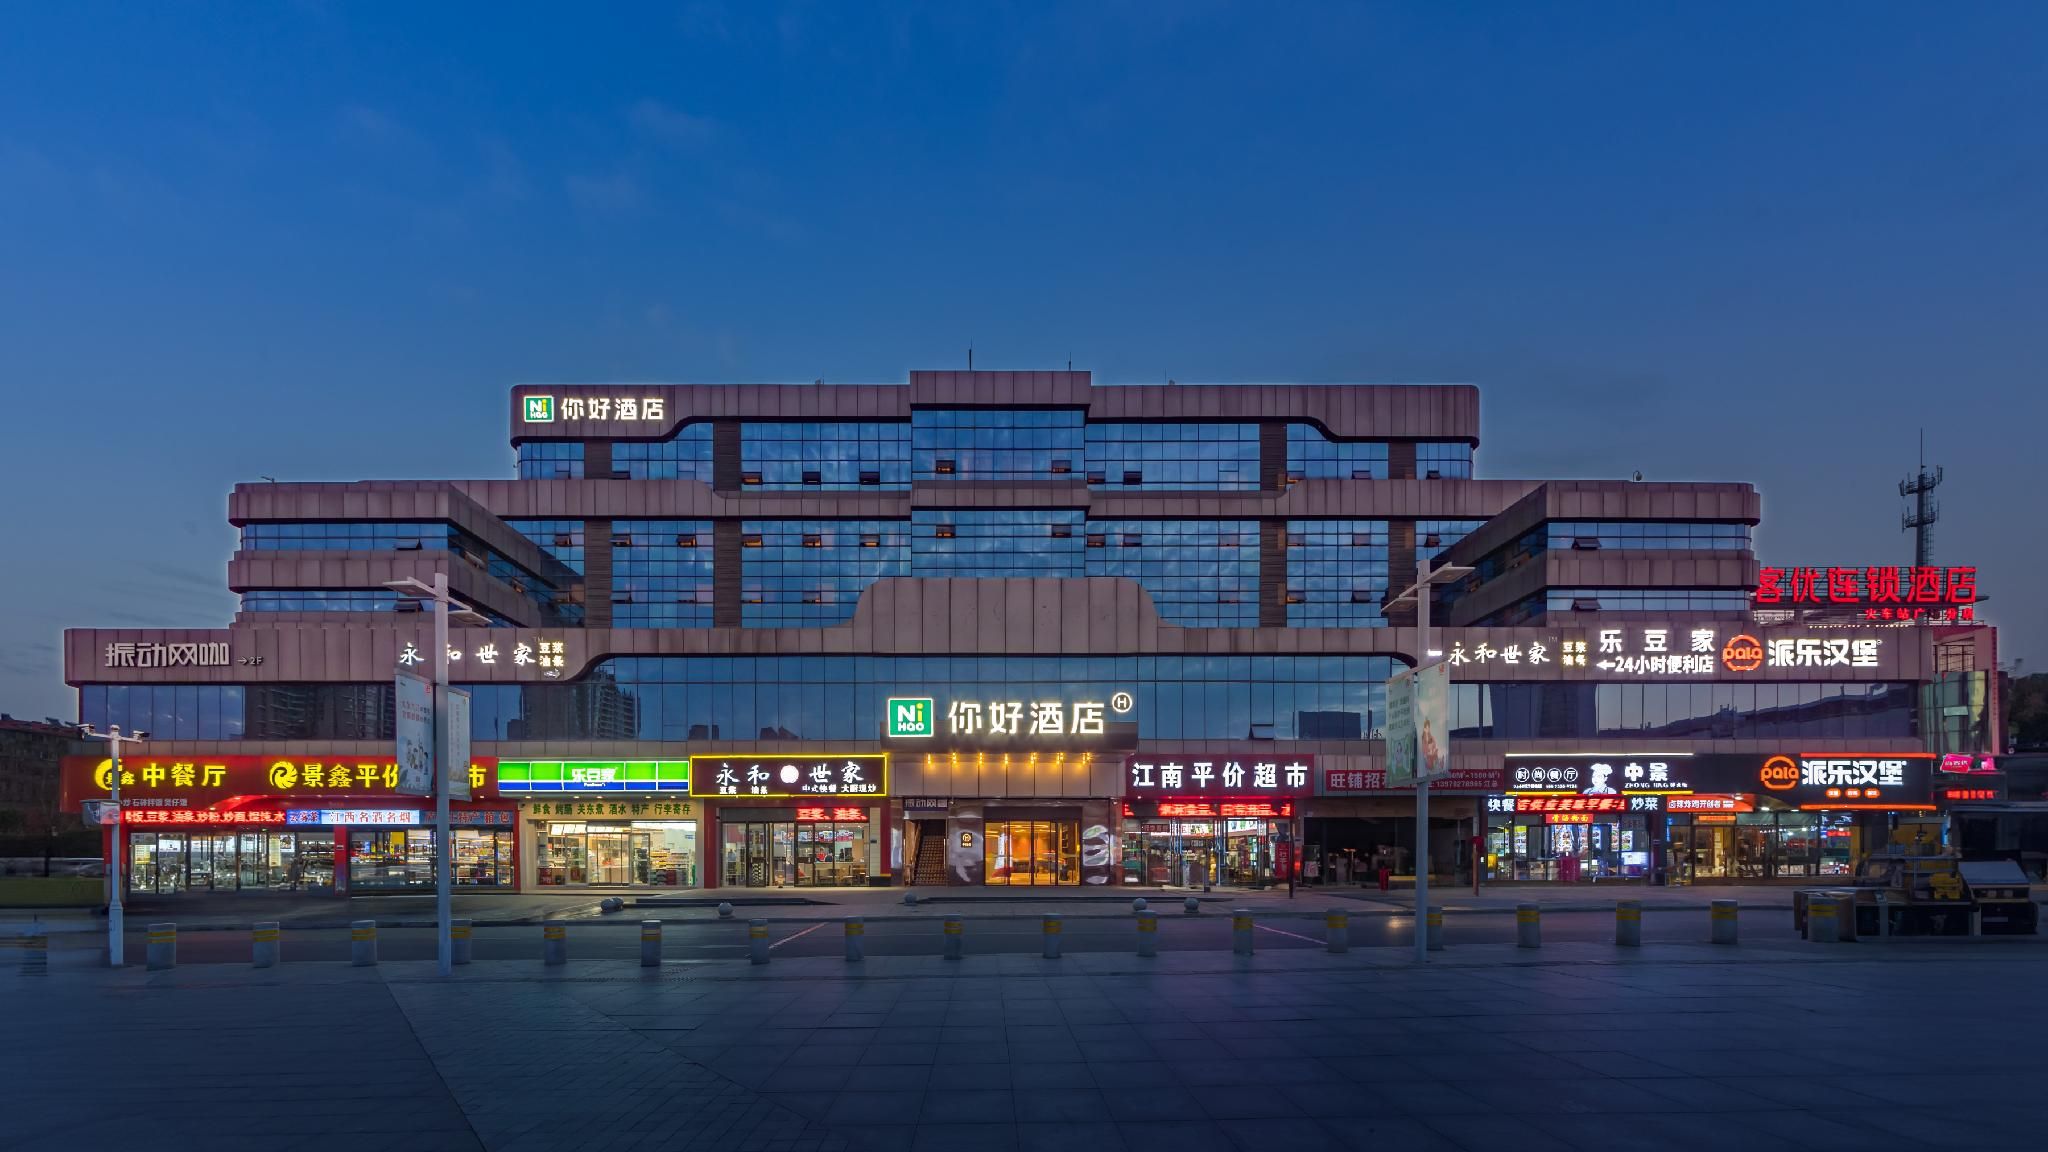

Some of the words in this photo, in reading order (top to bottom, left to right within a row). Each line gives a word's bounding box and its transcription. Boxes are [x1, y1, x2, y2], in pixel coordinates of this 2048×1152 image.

[529, 398, 548, 412] Ni
[560, 397, 665, 421] 你好酒店
[1756, 566, 1977, 603] 客优连锁酒店
[540, 642, 564, 654] 豆浆
[1600, 629, 1716, 653] 乐豆家
[104, 641, 231, 667] 振动网咖
[249, 656, 264, 666] 2F
[1448, 641, 1550, 666] 永和世家
[1767, 638, 1879, 667] 派乐汉堡
[1614, 655, 1714, 675] 24小时便利店
[897, 702, 924, 722] Ni
[948, 701, 1106, 734] 你好酒店
[142, 763, 227, 788] 中餐厅
[571, 766, 619, 783] 乐豆家
[715, 763, 771, 786] 永和
[808, 761, 865, 784] 世家
[1131, 761, 1308, 789] 江南平价超市
[1330, 772, 1386, 789] 旺铺招
[1515, 767, 1579, 783] 时尚餐厅
[1624, 762, 1669, 782] 中景
[1801, 760, 1904, 786] 派乐汉堡
[532, 803, 551, 815] 鲜食
[577, 803, 605, 815] 关东煮
[608, 803, 627, 815] 酒水
[654, 803, 692, 815] 行李寄存
[1487, 798, 1516, 812] 快餐
[1631, 797, 1659, 811] 炒菜
[329, 811, 411, 823] 江西名酒名烟
